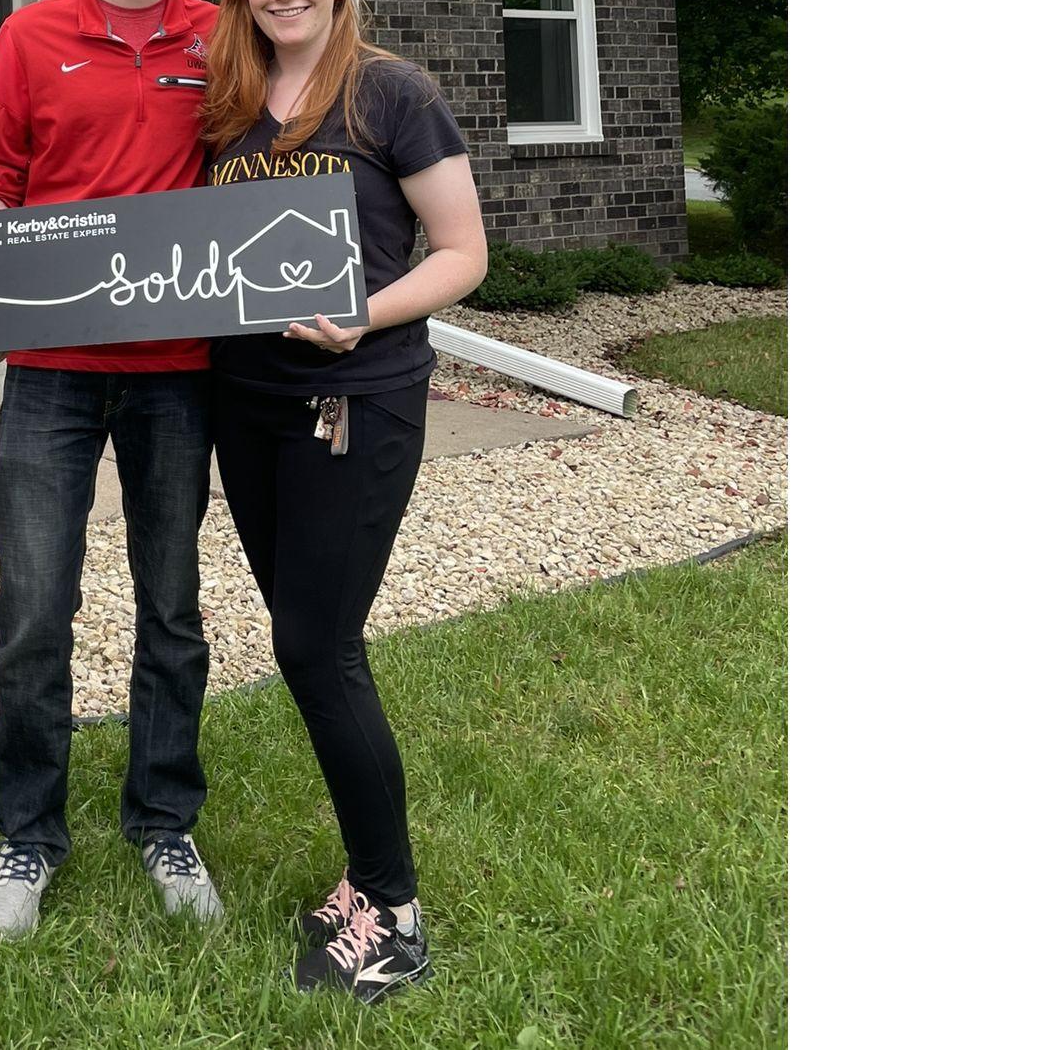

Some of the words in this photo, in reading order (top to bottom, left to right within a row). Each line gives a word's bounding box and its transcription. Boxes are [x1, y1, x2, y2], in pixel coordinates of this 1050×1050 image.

[7, 212, 117, 235] Kerby&Cristina
[7, 235, 32, 245] REAL
[35, 231, 70, 242] ESTATE
[73, 226, 117, 238] EXPERTS
